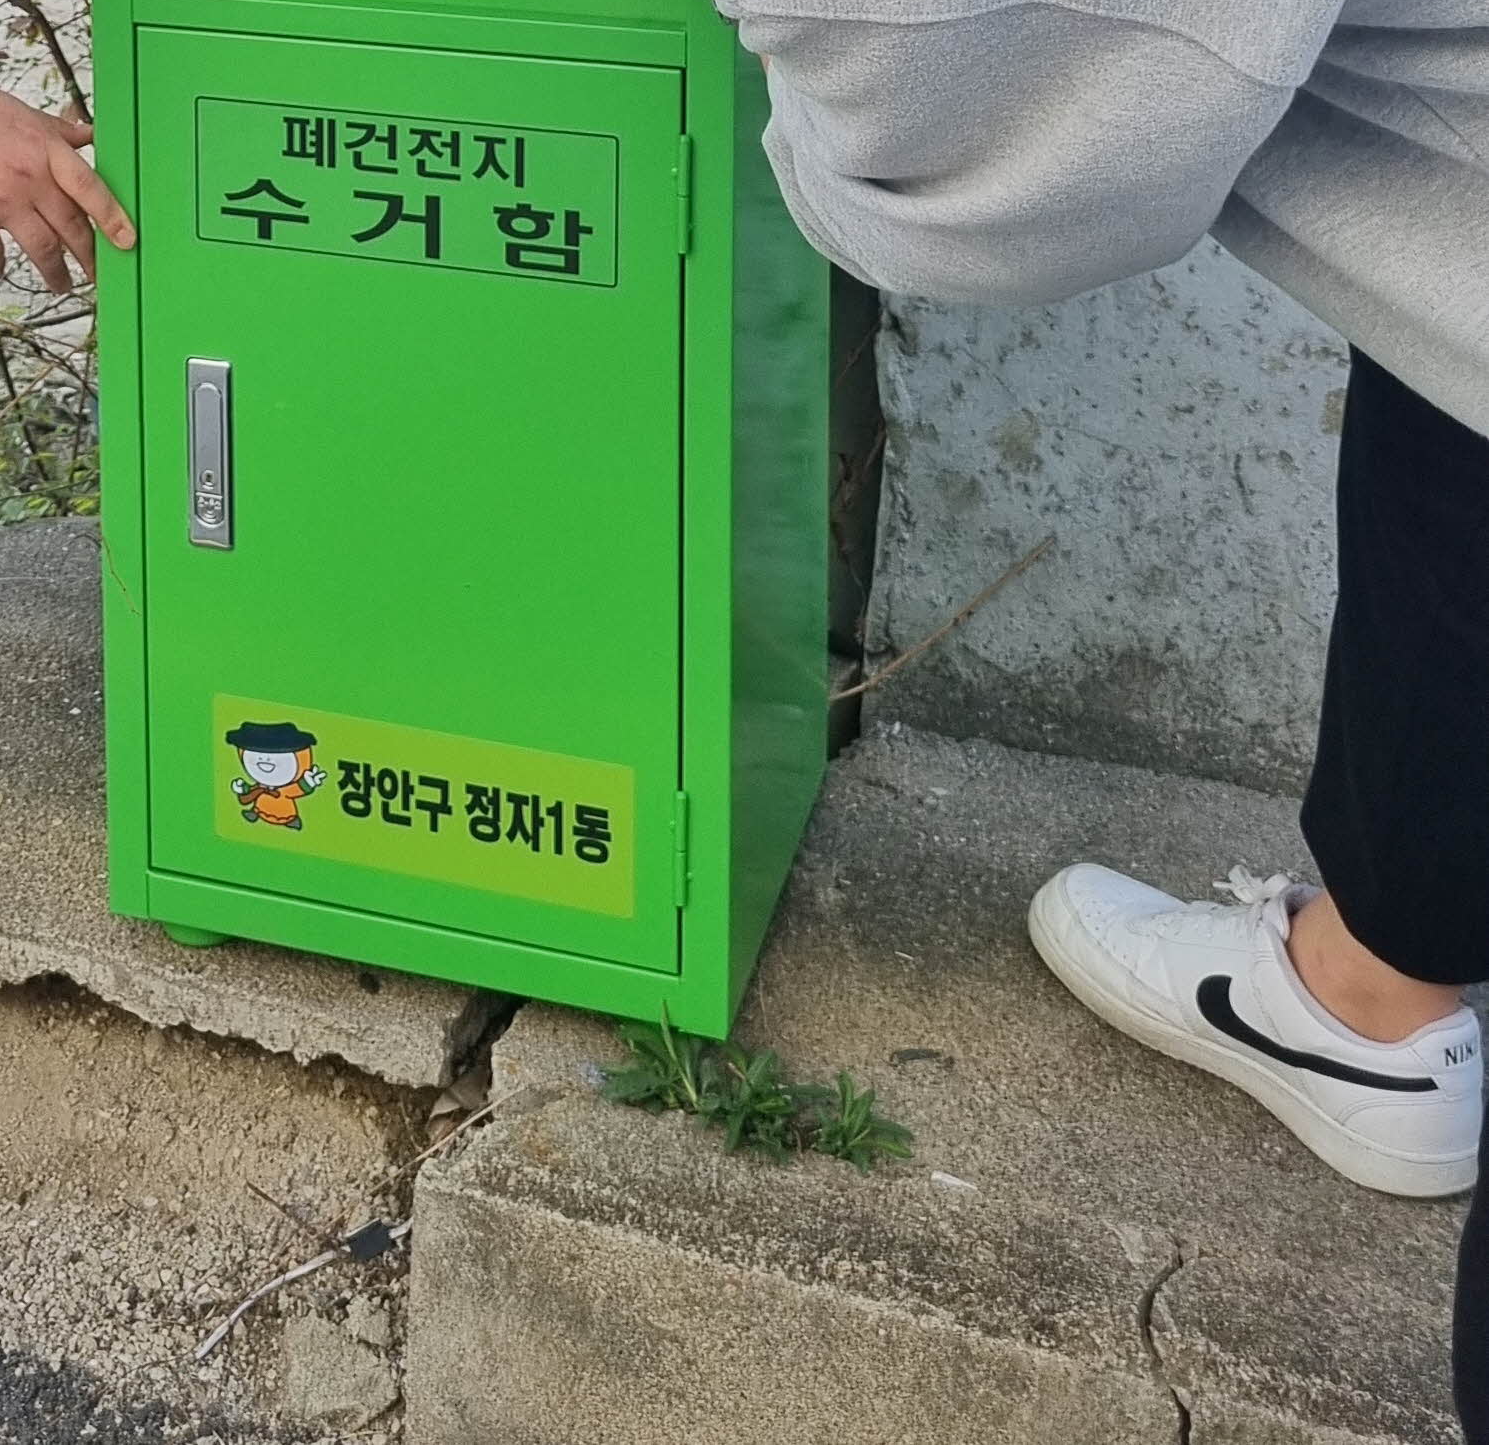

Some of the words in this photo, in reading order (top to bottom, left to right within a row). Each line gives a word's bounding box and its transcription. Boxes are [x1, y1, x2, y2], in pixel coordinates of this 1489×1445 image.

[282, 116, 526, 189] 폐건전지
[337, 759, 453, 832] 장안구
[464, 783, 612, 864] 정자1동
[1445, 1042, 1476, 1067] NIK
